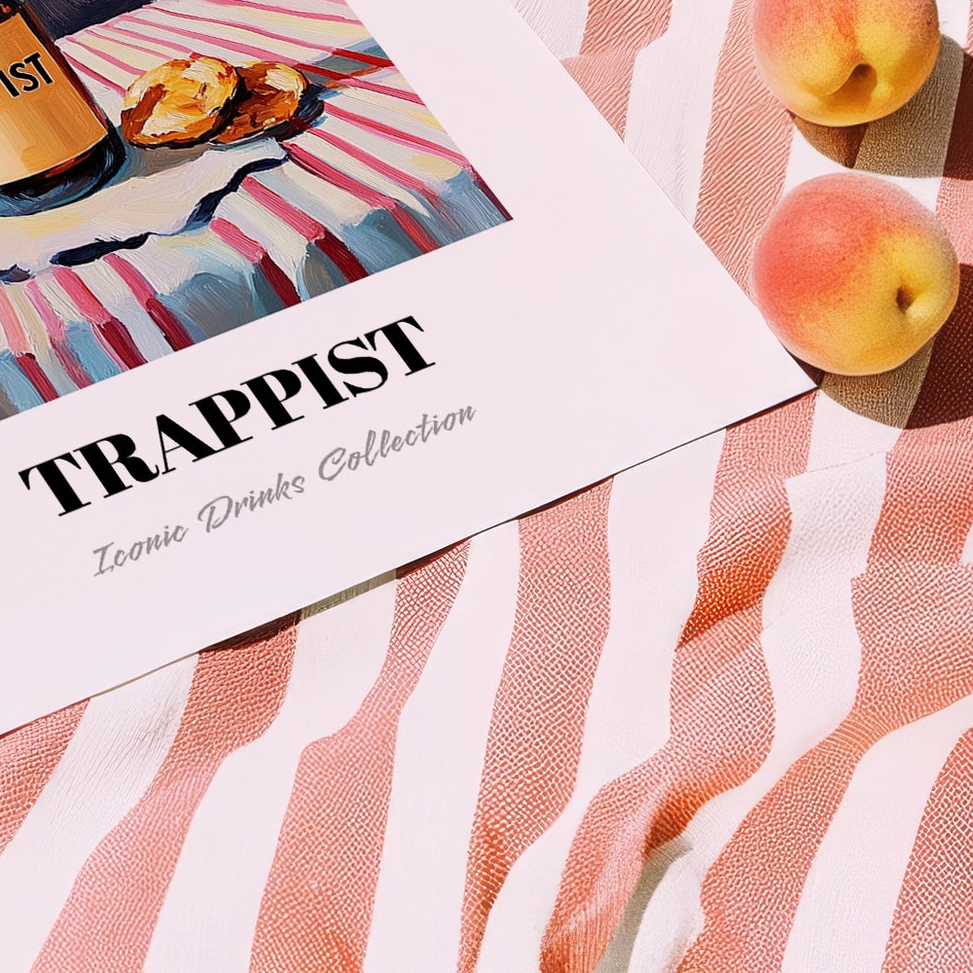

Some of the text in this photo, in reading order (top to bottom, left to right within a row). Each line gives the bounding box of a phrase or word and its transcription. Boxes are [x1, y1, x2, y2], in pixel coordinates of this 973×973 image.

[18, 315, 436, 517] TRAPPIST
[93, 405, 477, 577] Iconic Drinks Collection
